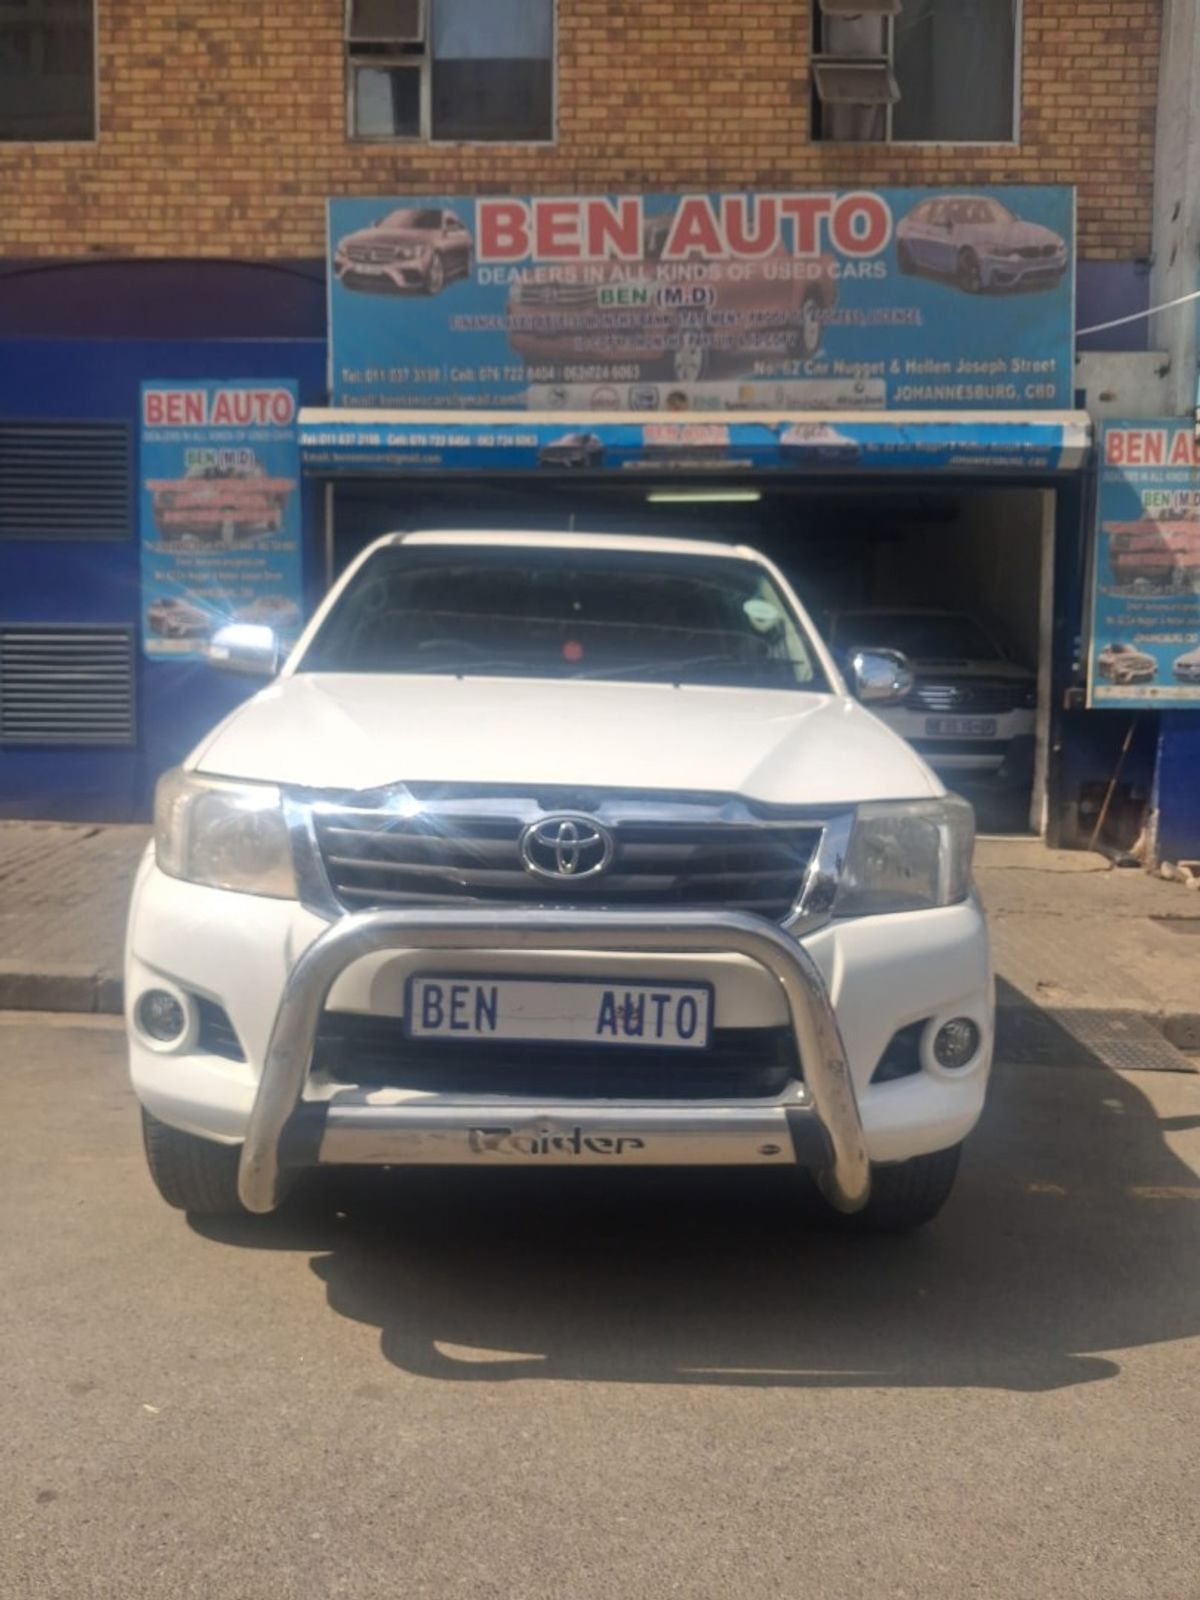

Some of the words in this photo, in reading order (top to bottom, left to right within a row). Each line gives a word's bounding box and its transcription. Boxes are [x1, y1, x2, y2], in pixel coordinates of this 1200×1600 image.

[475, 196, 646, 262] BEN
[661, 191, 893, 260] AUTO
[477, 267, 575, 285] DEALERS
[584, 266, 601, 283] IN
[609, 265, 647, 283] ALL
[656, 264, 723, 282] KINDS
[728, 264, 755, 281] OF
[762, 263, 821, 280] USED
[827, 262, 887, 279] CARS
[600, 287, 648, 305] BEN
[656, 287, 717, 307] (M.D)
[834, 359, 885, 380] Nugget
[890, 360, 901, 374] &
[956, 359, 1007, 377] Joseph
[1011, 357, 1056, 373] Street
[1025, 384, 1056, 399] CBD
[144, 390, 207, 426] BEN
[211, 388, 294, 426] AUTO
[186, 448, 215, 467] BEN
[1105, 429, 1168, 466] BEN
[1143, 489, 1170, 508] BEN
[421, 984, 498, 1031] BEN
[596, 991, 698, 1040] AUTO
